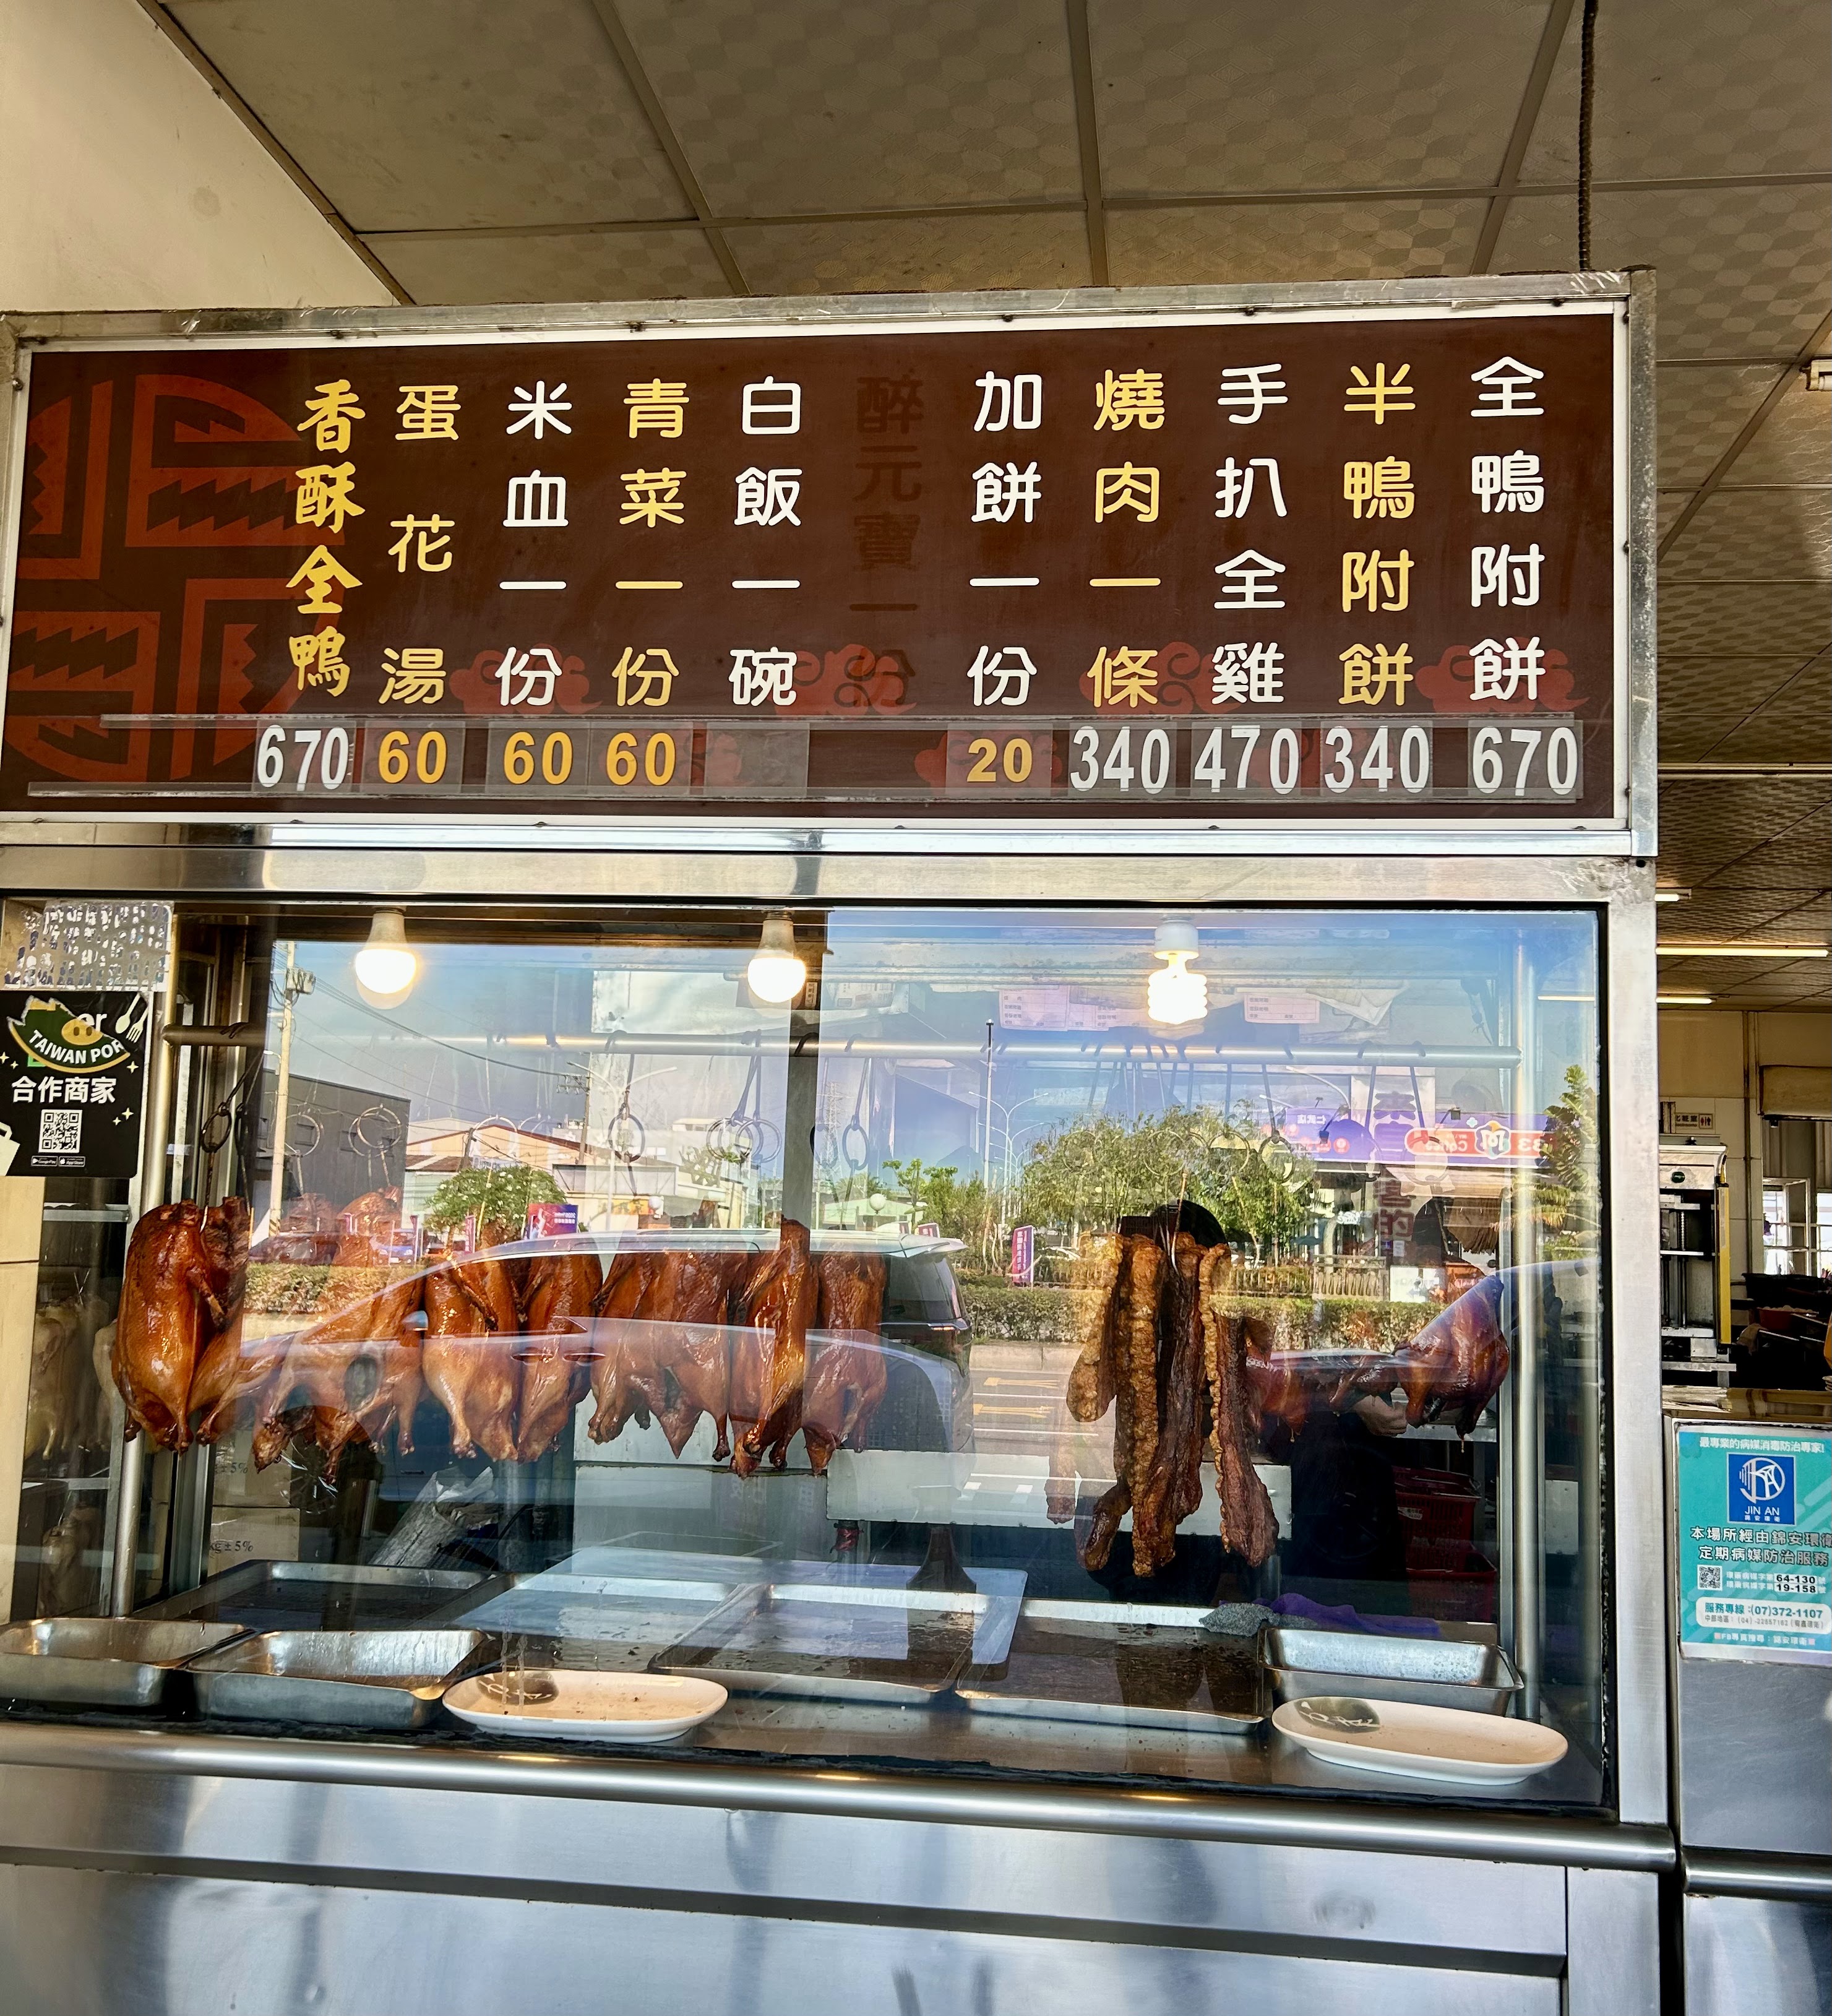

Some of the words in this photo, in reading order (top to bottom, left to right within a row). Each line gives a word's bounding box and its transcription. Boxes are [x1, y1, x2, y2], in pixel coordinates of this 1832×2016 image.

[286, 379, 366, 697] 香酥全鴨
[379, 384, 462, 705] 蛋花湯
[495, 381, 572, 707] 米血一份
[611, 378, 690, 707] 青菜一份
[728, 376, 802, 707] 白飯一碗
[967, 371, 1042, 707] 加餅一份
[1087, 368, 1165, 708] 燒肉一條
[1211, 363, 1288, 705] 手扒全雞
[1338, 362, 1416, 706] 半鴨附餅
[1469, 356, 1546, 700] 全鴨附餅
[258, 724, 349, 791] 670
[379, 731, 446, 783] 60
[504, 731, 572, 784] 60
[607, 733, 675, 785] 60
[967, 738, 1033, 783] 20
[1070, 725, 1170, 795] 340
[1194, 725, 1299, 795] 470
[1325, 725, 1430, 794] 340
[1473, 727, 1578, 796] 670
[29, 1029, 87, 1064] TAIWAN
[11, 1075, 118, 1105] 合作商家
[1744, 1506, 1761, 1515] JIN
[1765, 1506, 1780, 1516] AN
[234, 1540, 254, 1553] 5%
[1699, 1545, 1829, 1567] 定期病媒防治服務
[1776, 1574, 1816, 1584] 64-130
[1776, 1583, 1817, 1593] 19-158
